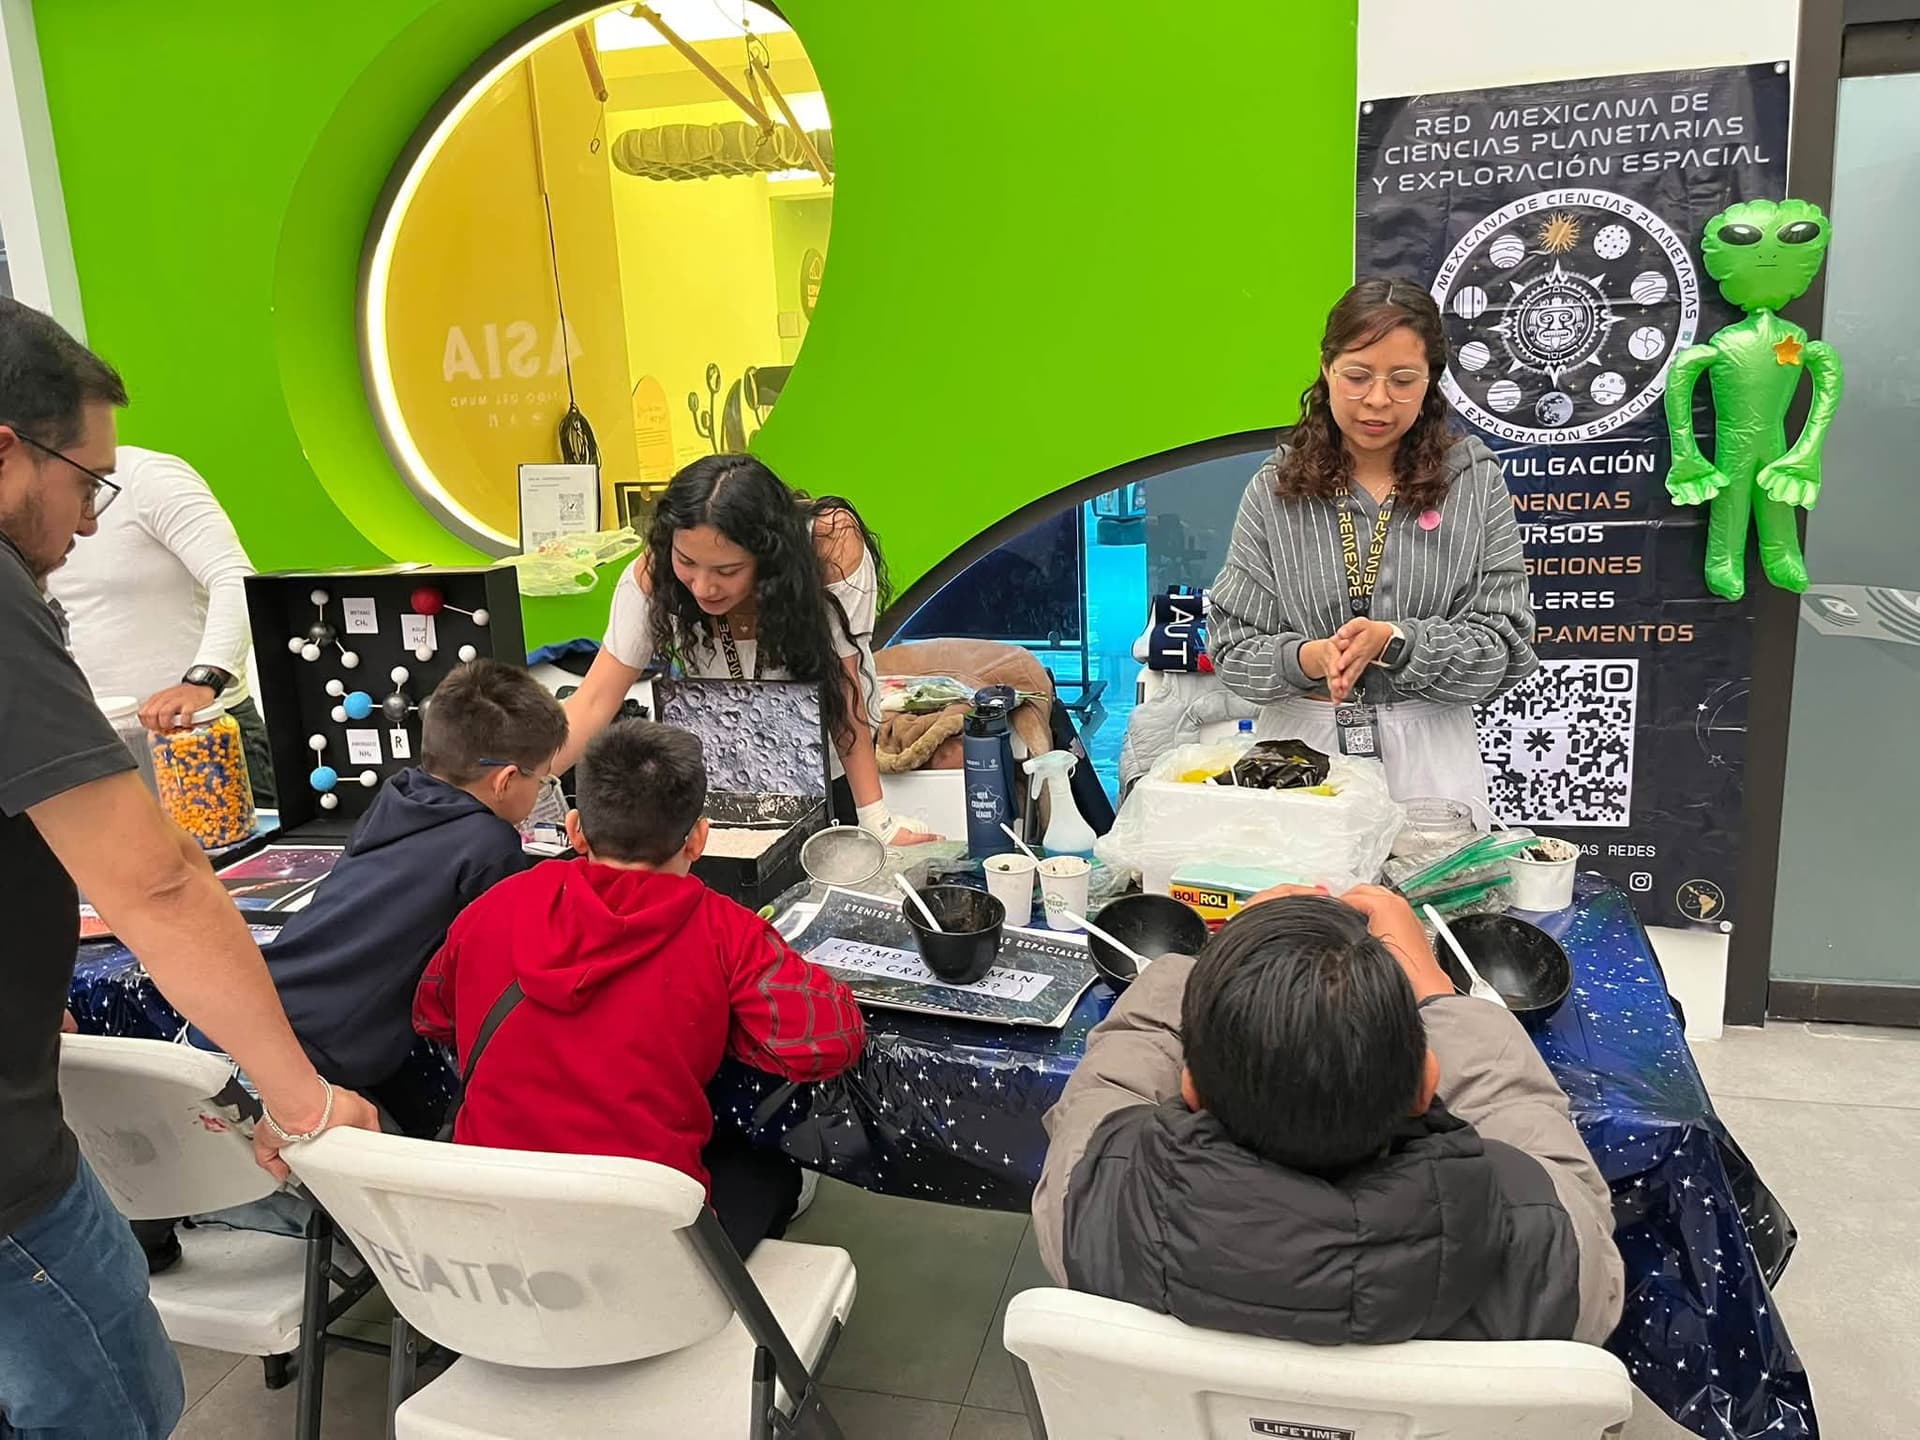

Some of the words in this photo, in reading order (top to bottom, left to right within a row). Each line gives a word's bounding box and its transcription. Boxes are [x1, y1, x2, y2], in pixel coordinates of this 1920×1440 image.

[1416, 115, 1470, 137] RED
[1490, 97, 1658, 130] MEXICANA
[1671, 93, 1709, 113] DE
[1385, 136, 1520, 165] CIENCIAS
[1532, 116, 1744, 152] PLANETARIAS
[1373, 176, 1389, 194] Y
[1399, 154, 1610, 192] EXPLORACIÓN
[1622, 145, 1770, 173] ESPACIAL
[1437, 212, 1510, 291] MEXICANA
[1515, 199, 1538, 215] DE
[1546, 193, 1634, 216] CIENCIAS
[1636, 211, 1697, 320] PLANETARIAS
[1456, 396, 1465, 406] Y
[1465, 408, 1581, 442] EXPLORACIÓN
[1588, 385, 1665, 436] ESPACIAL
[1511, 491, 1631, 512] NENCIAS
[1520, 525, 1604, 544] URSOS
[1338, 511, 1361, 597] REMEXPE
[1362, 510, 1391, 595] REMEXPE
[1524, 556, 1642, 575] SICIONES
[1530, 591, 1615, 609] LERES
[1532, 624, 1694, 644] PAMENTOS
[720, 624, 742, 678] MEXPE
[395, 736, 403, 748] R
[1608, 844, 1656, 857] REDES
[844, 903, 892, 920] EVENTOS
[1016, 939, 1089, 960] ESPACIALES
[840, 956, 876, 969] LOS
[987, 969, 1034, 984] MAN
[352, 1227, 584, 1311] TEATRO
[1263, 1423, 1340, 1440] LIFETIME
